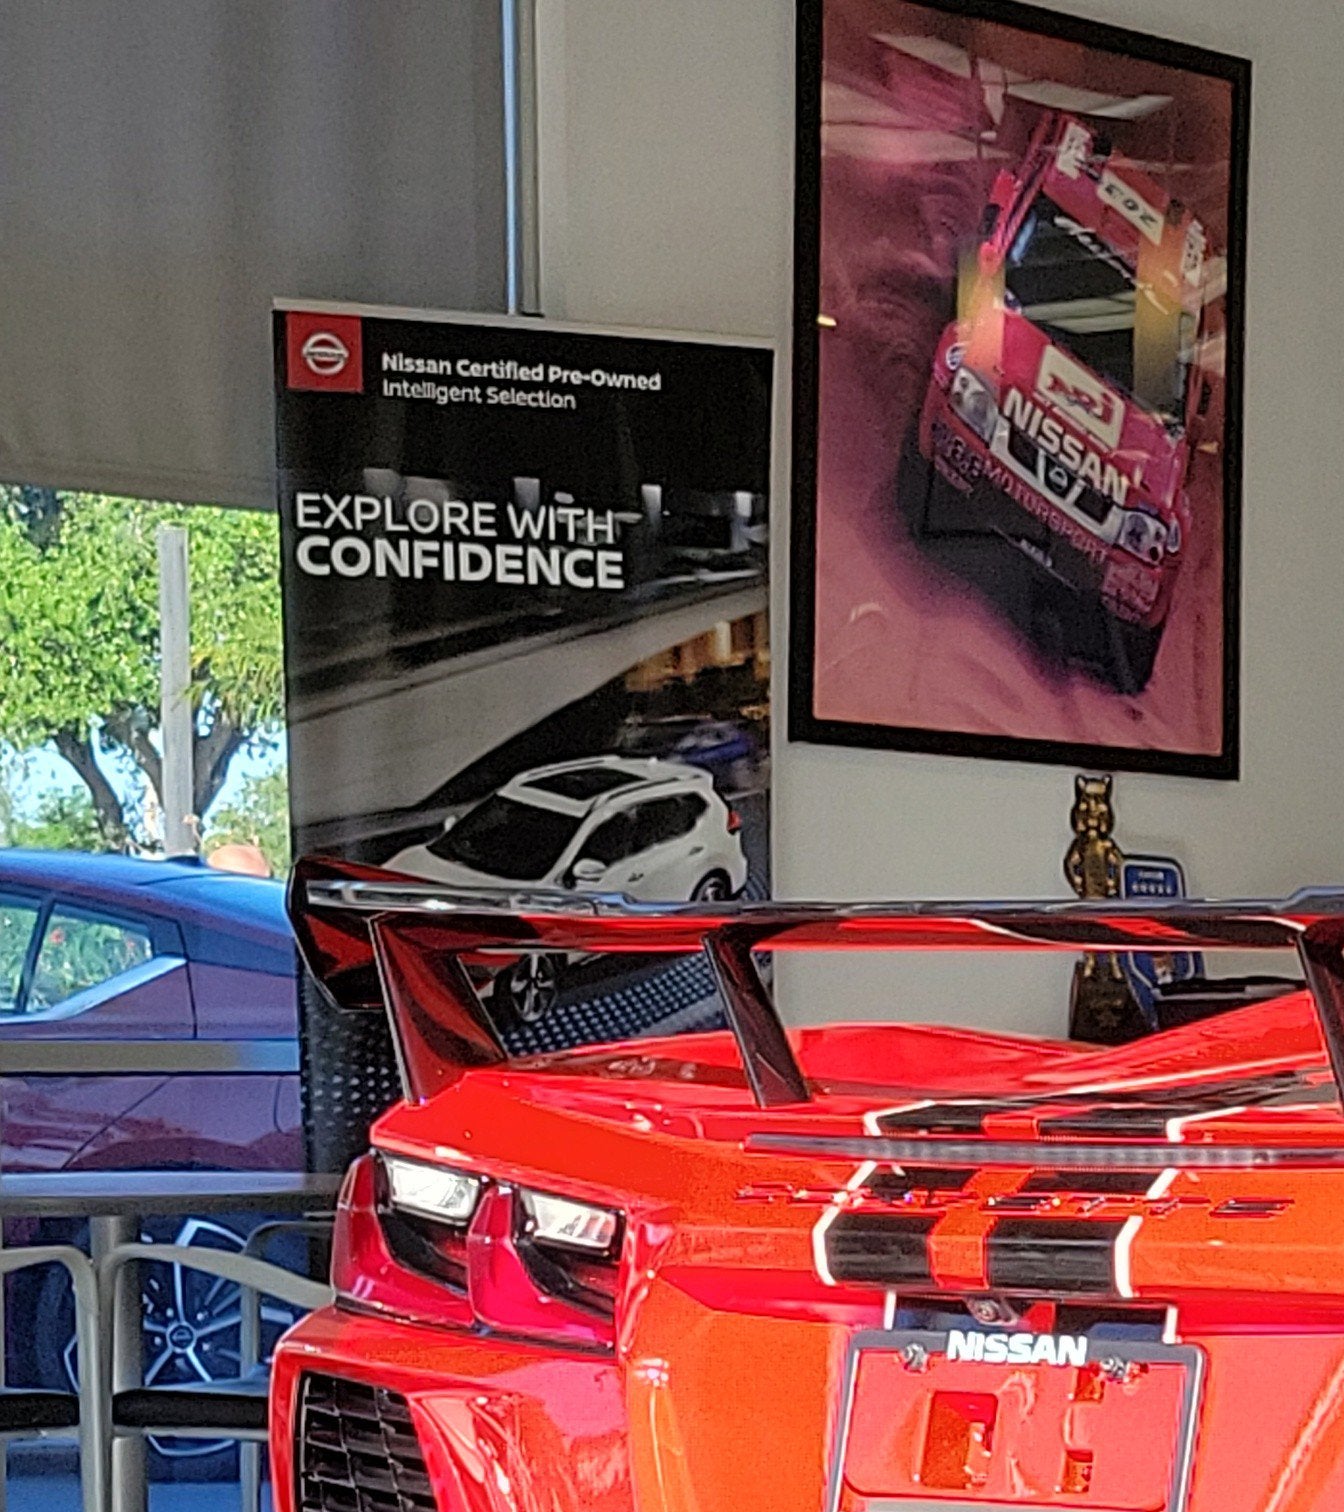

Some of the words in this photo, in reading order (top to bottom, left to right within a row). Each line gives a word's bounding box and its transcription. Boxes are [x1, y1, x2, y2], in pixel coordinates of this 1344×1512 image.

[381, 352, 451, 376] Nissan
[456, 359, 544, 382] Certified
[548, 364, 661, 391] Pre-Owned
[382, 378, 483, 405] Intelligent
[486, 386, 577, 410] Selection
[1003, 387, 1130, 506] NISSAN
[295, 493, 497, 539] EXPLORE
[506, 503, 615, 544] WITH
[296, 535, 625, 590] CONFIDENCE
[947, 1330, 1088, 1366] NISSAN
